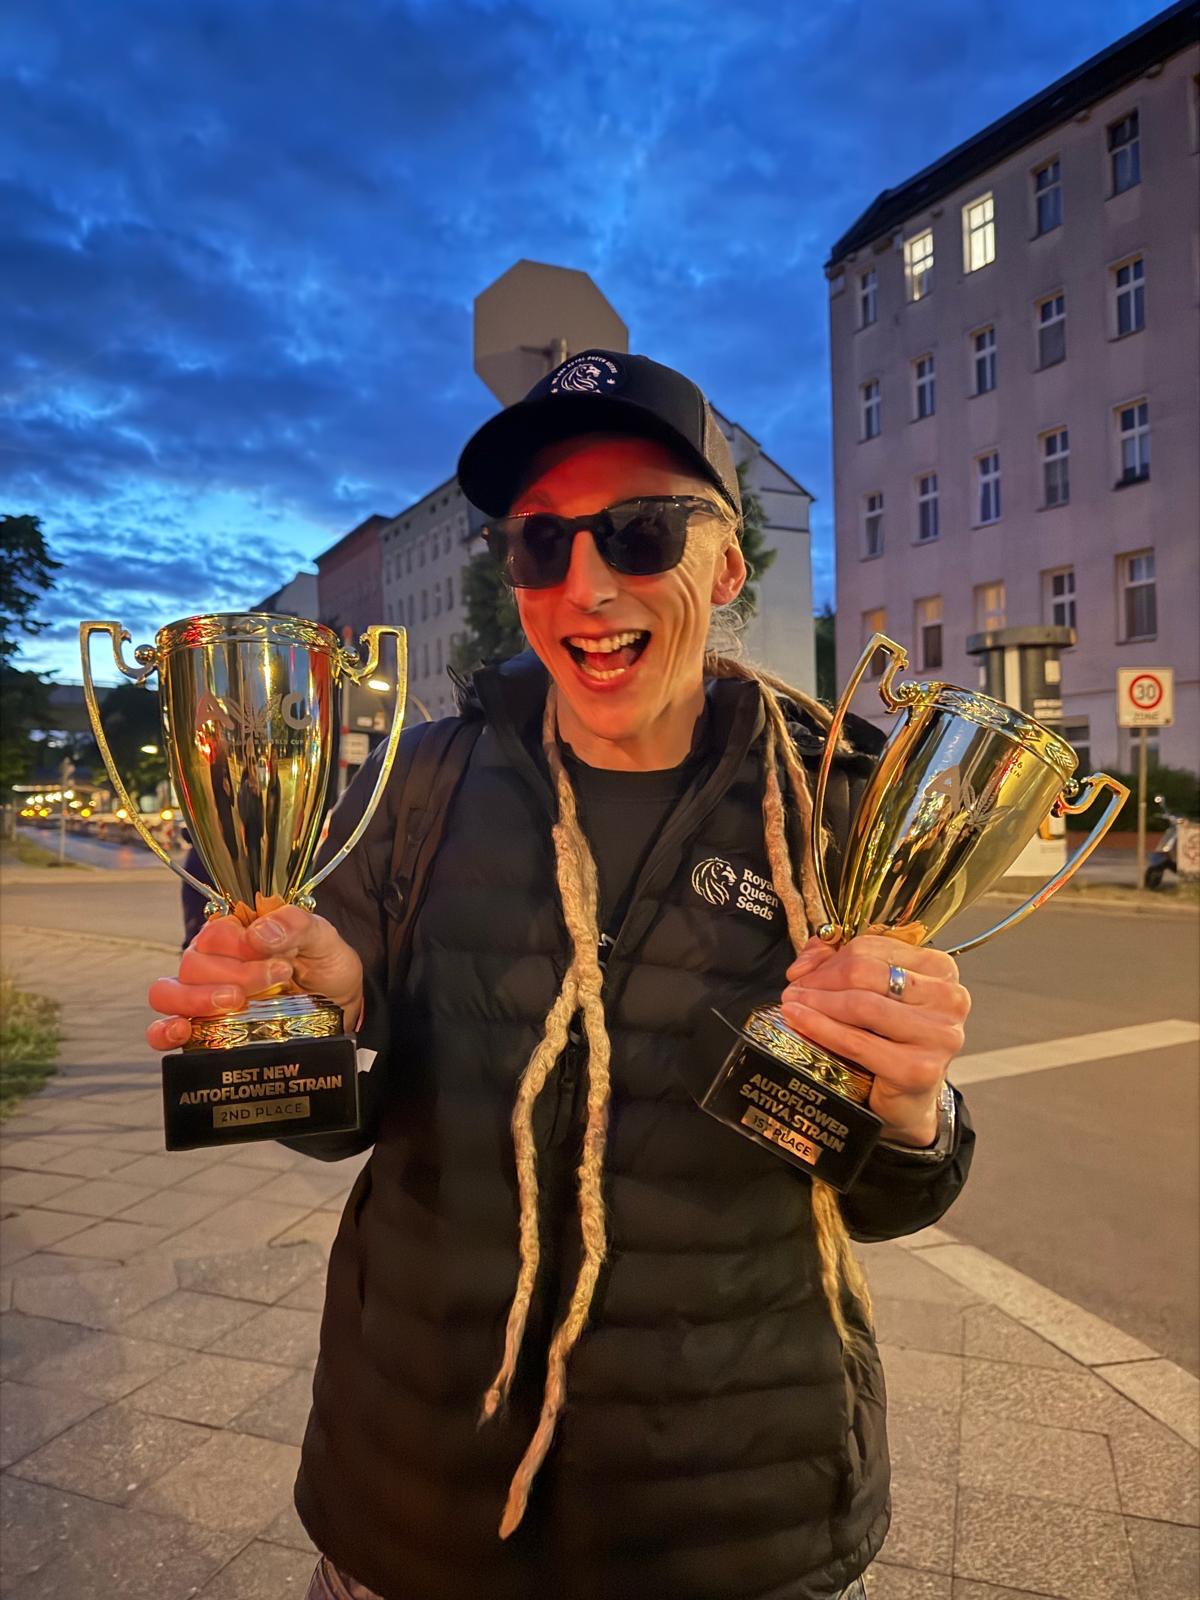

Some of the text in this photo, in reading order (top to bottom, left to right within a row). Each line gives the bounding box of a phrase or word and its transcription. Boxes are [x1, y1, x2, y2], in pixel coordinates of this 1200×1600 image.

[1136, 684, 1156, 700] 30
[743, 868, 774, 892] Roya
[736, 896, 774, 920] Seeds
[740, 882, 778, 908] Queen
[222, 1063, 300, 1084] BEST NEW
[179, 1074, 343, 1105] AUTOFLOWER STRAIN
[788, 1078, 827, 1105] BEST
[221, 1103, 303, 1122] 2ND PLACE
[740, 1084, 846, 1153] SATIVA STRAIN
[750, 1073, 849, 1139] AUTOFLOWER
[773, 1128, 812, 1157] PLACE
